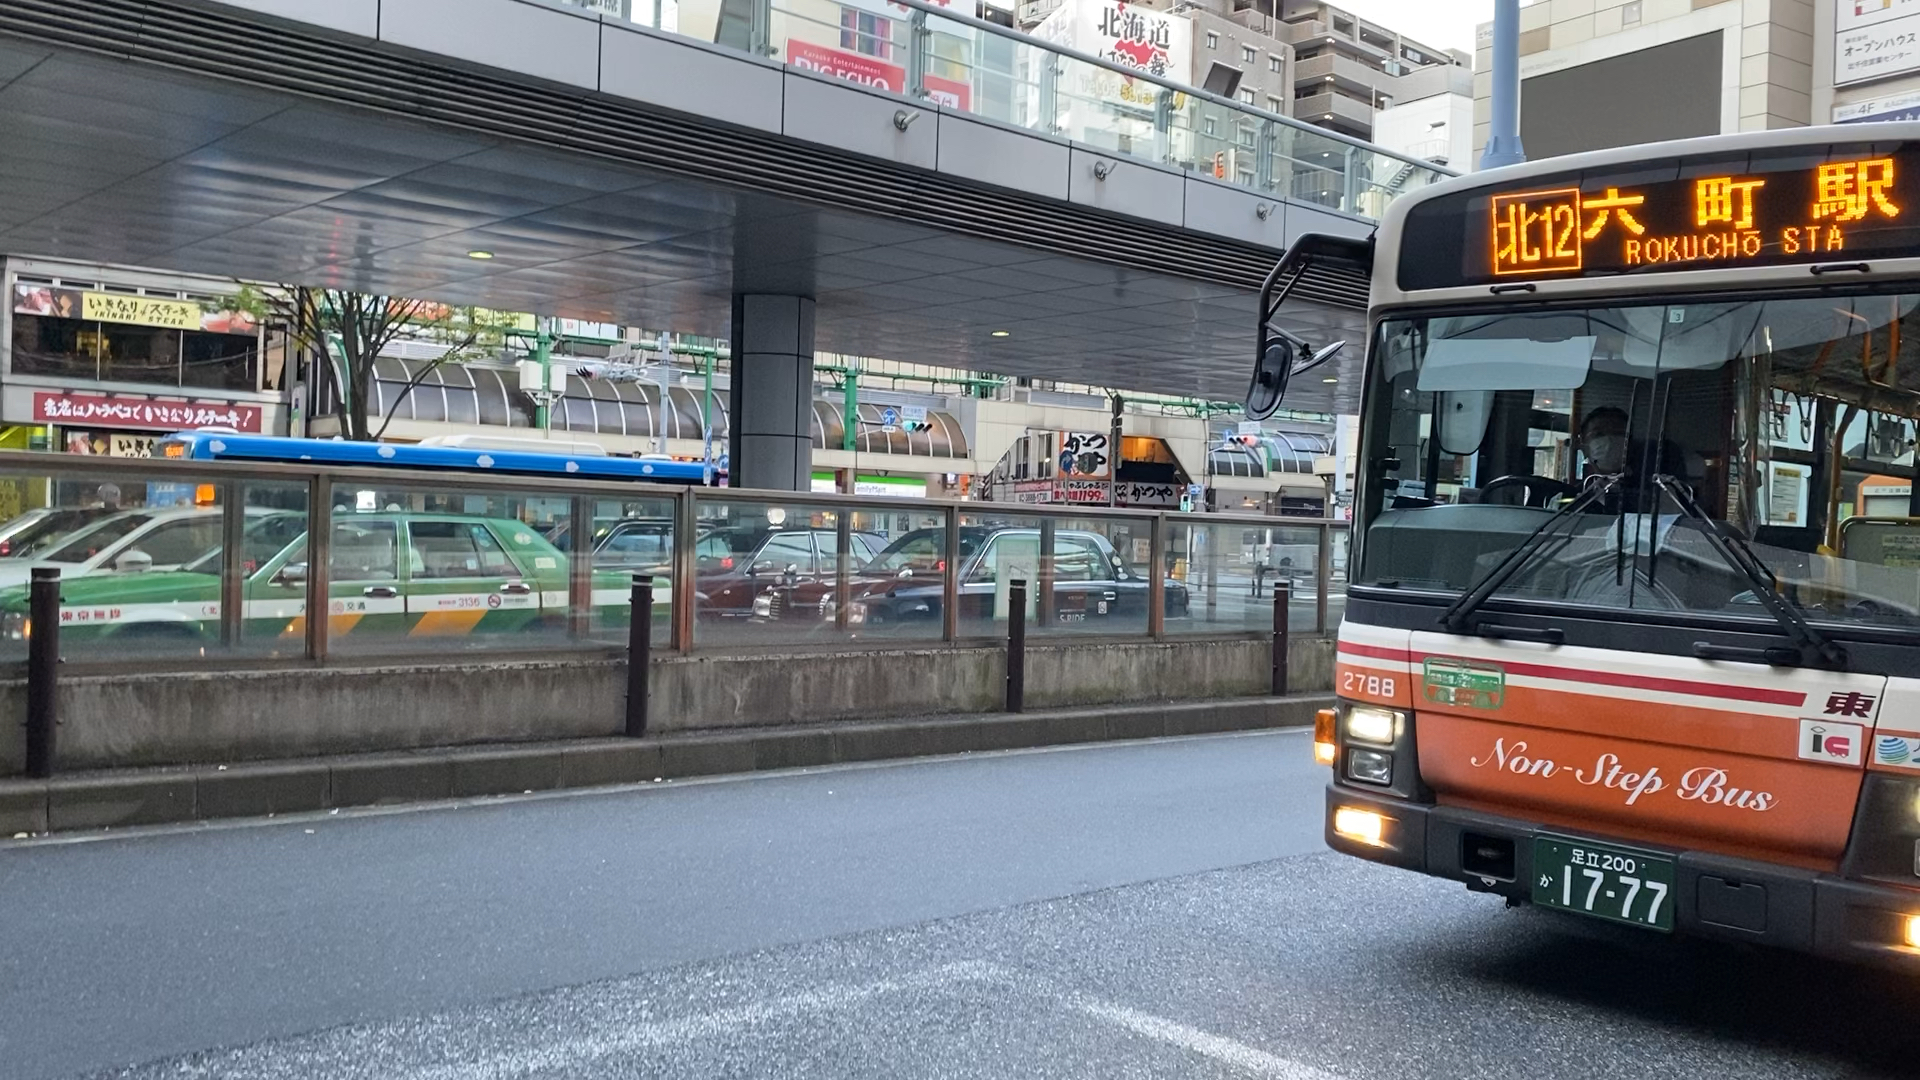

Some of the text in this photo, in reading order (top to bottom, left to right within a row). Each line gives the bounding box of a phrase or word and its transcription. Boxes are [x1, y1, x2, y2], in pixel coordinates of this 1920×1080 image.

[1098, 6, 1171, 49] 北海道
[1844, 33, 1916, 56] オープンハウス
[833, 57, 881, 75] Entertainment
[1858, 103, 1875, 115] 4F
[1498, 203, 1575, 265] 北12
[1784, 225, 1844, 254] STA
[88, 297, 189, 318] いきなり ステーキ
[94, 310, 185, 326] IKINARI STEAK
[1131, 483, 1173, 502] かつや
[458, 597, 480, 608] 3136
[1343, 671, 1395, 698] 2788
[1470, 737, 1780, 812] Non-Step Bus
[1539, 865, 1668, 924] か 17-77
